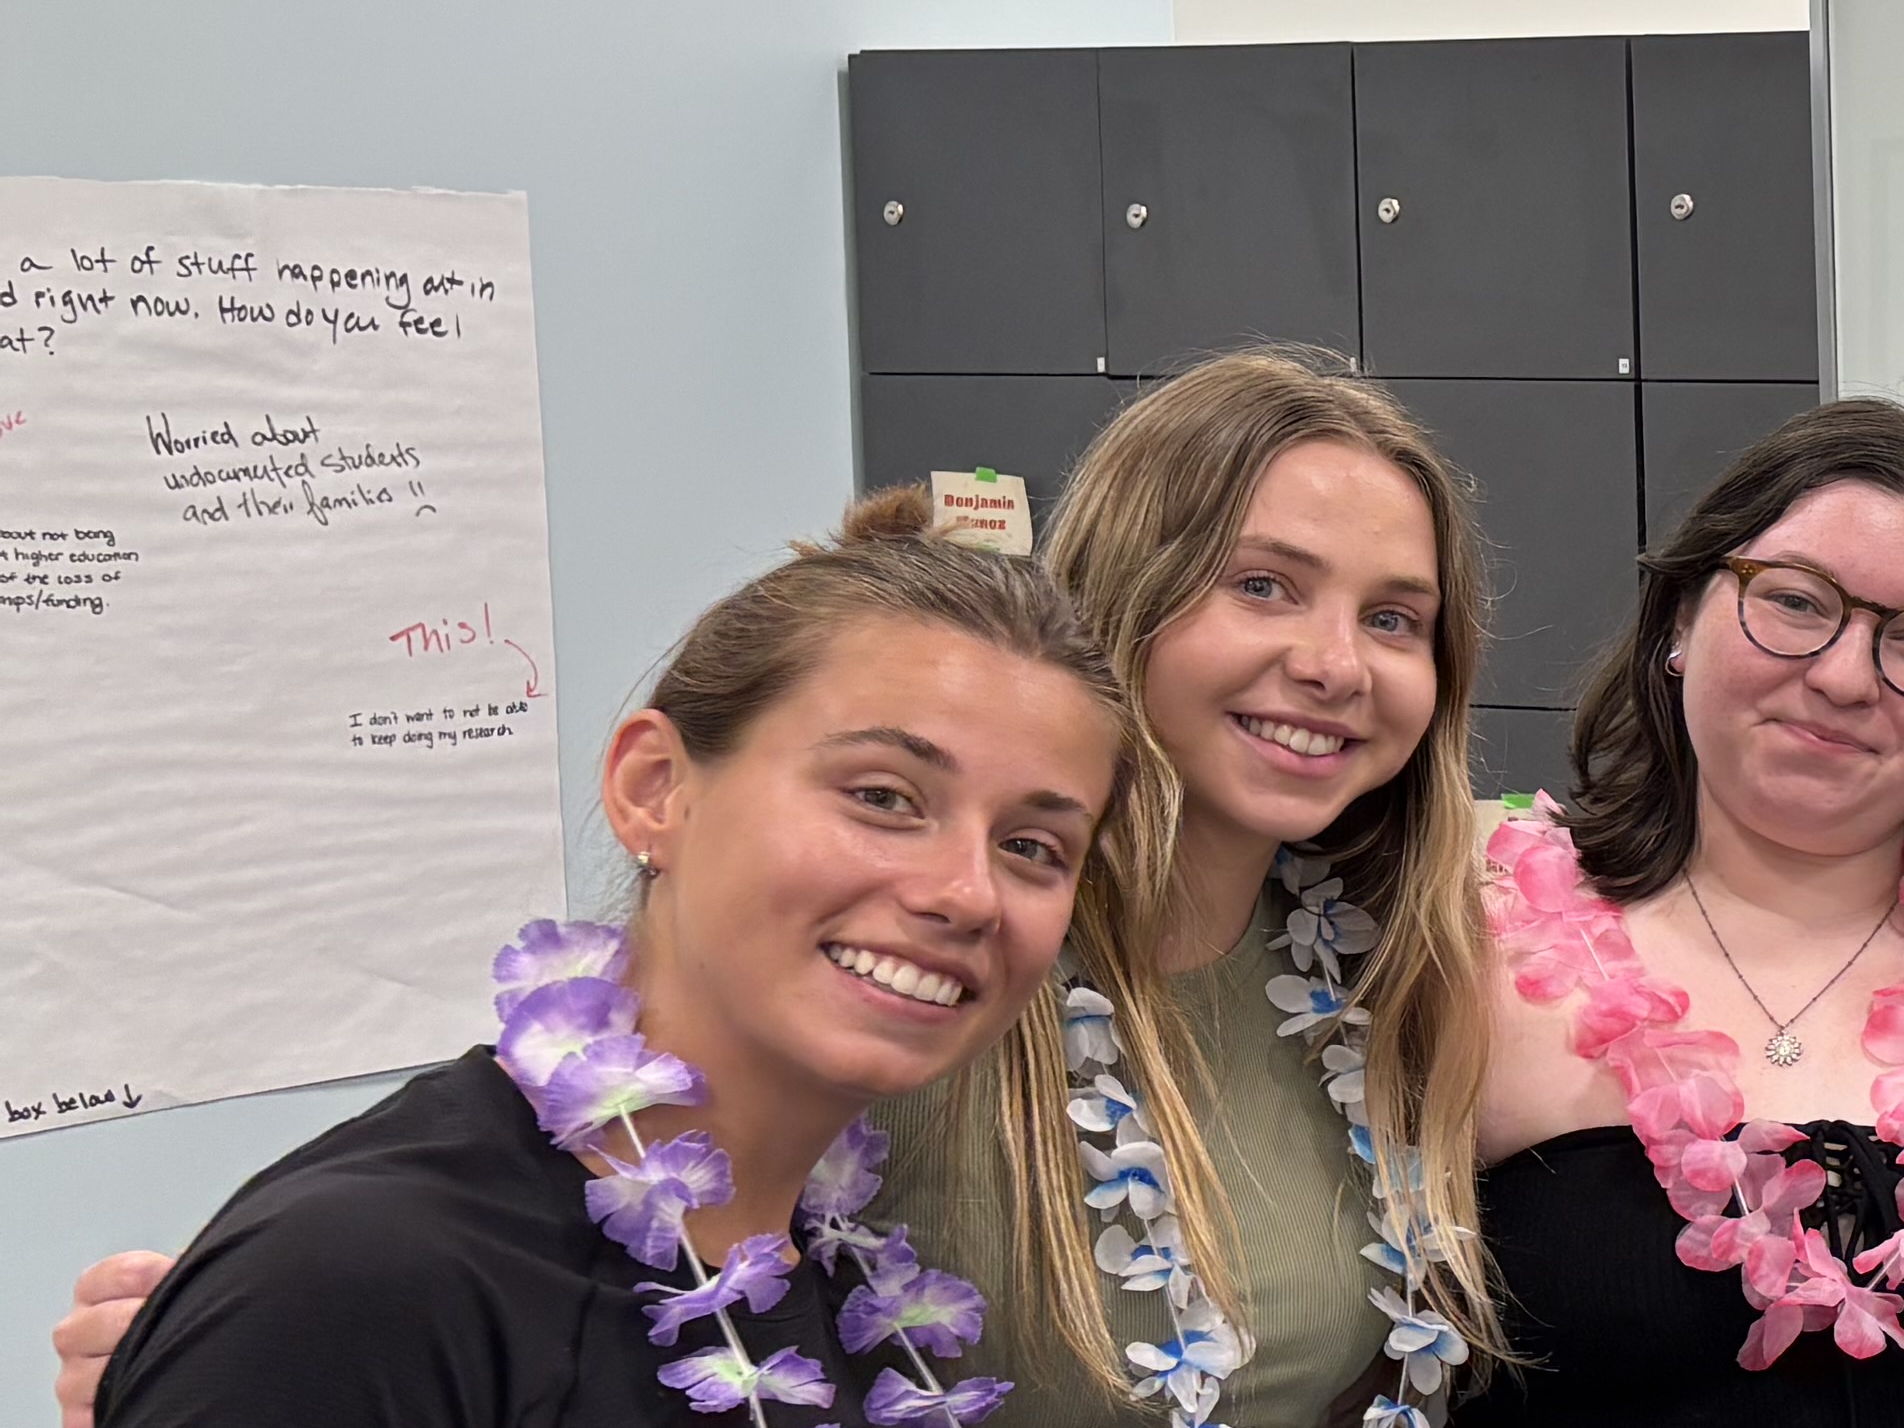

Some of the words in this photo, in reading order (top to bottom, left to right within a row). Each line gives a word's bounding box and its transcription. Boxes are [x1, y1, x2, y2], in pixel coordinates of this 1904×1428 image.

[20, 256, 53, 272] a
[70, 246, 117, 273] lot
[130, 246, 163, 275] of
[175, 251, 258, 282] stuff
[470, 276, 495, 302] in
[34, 287, 116, 324] right
[130, 292, 200, 320] now.
[218, 294, 276, 325] How
[285, 299, 315, 328] do
[321, 307, 380, 345] you
[398, 307, 461, 340] feel
[146, 412, 239, 456] Worried
[251, 414, 320, 447] about
[182, 495, 230, 526] and
[237, 487, 294, 518] their
[944, 493, 1015, 511] Benjamin
[41, 531, 69, 542] not
[14, 547, 64, 568] higher
[24, 573, 49, 586] the
[57, 573, 94, 586] loss
[101, 570, 122, 583] of
[389, 602, 494, 658] This!
[368, 710, 399, 726] don't
[405, 708, 434, 723] want
[443, 706, 455, 720] to
[463, 703, 480, 718] not
[351, 735, 364, 747] to
[371, 733, 397, 748] keep
[402, 730, 434, 750] doing
[438, 730, 458, 747] my
[462, 723, 514, 741] research
[4, 1099, 47, 1123] box
